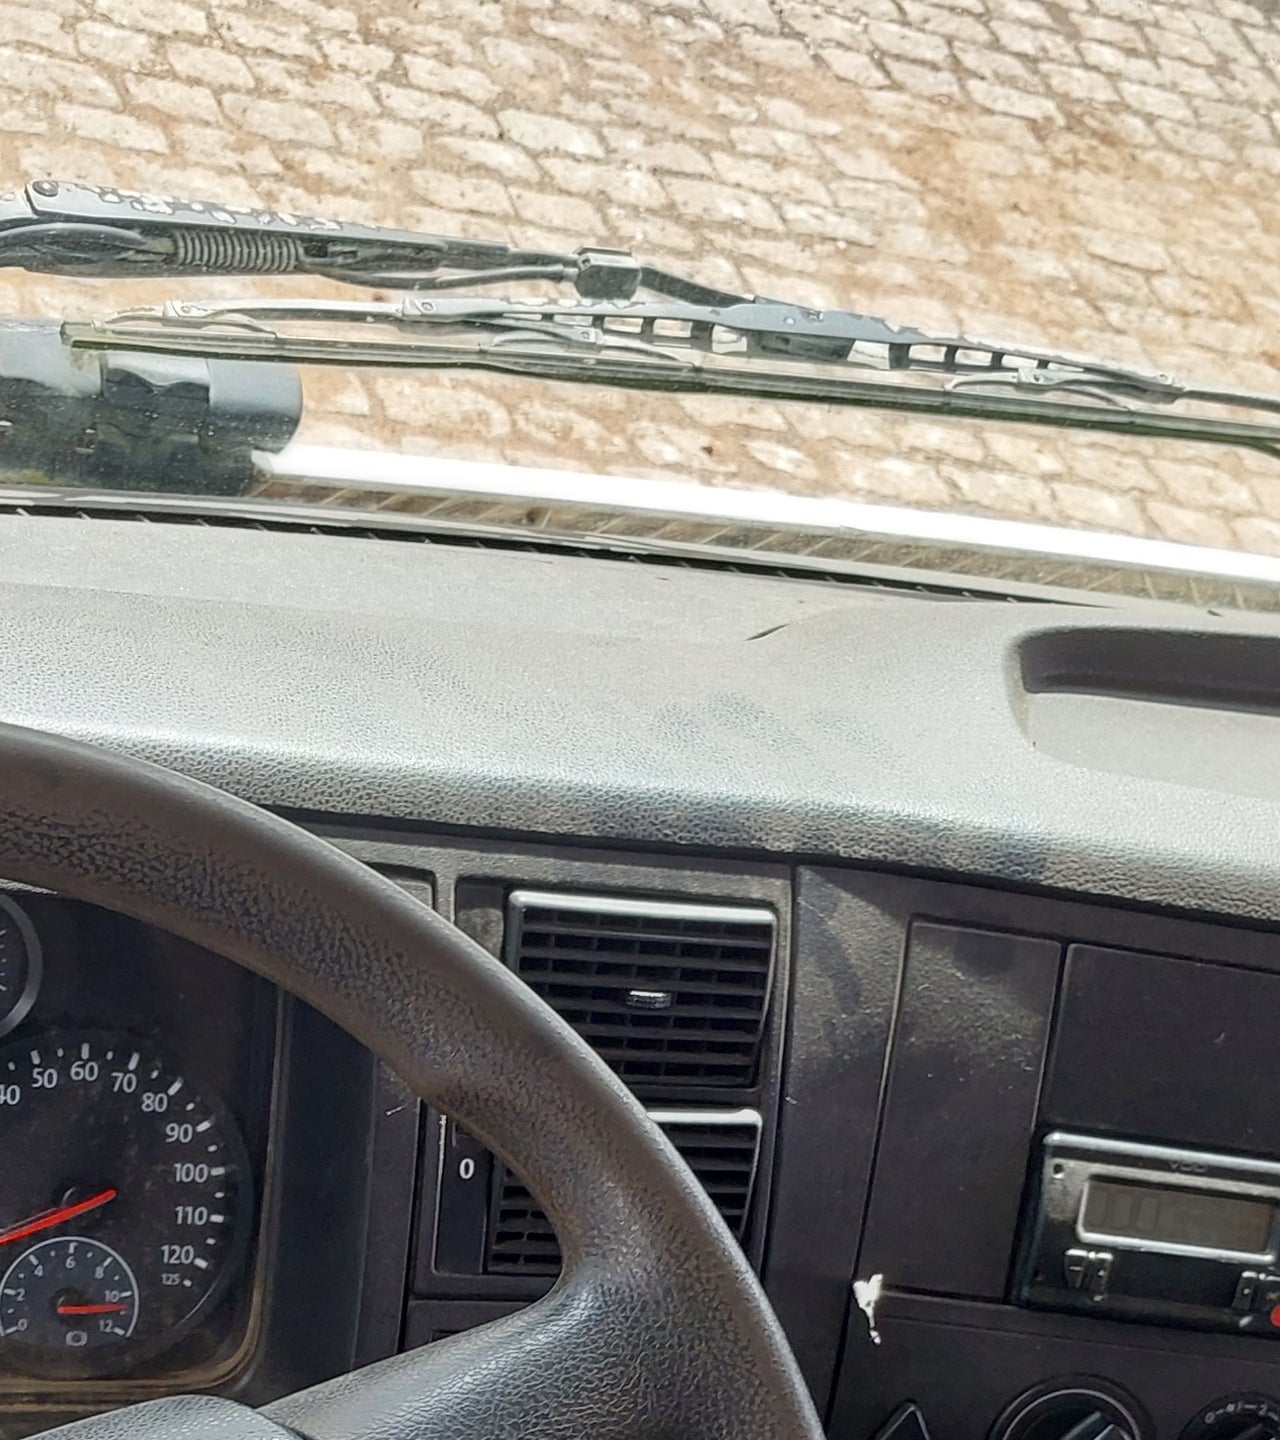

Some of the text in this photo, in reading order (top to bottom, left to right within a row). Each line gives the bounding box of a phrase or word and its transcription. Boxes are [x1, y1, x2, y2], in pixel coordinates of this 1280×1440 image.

[31, 1068, 58, 1088] 50
[70, 1061, 99, 1081] 60
[111, 1073, 137, 1093] 70
[141, 1092, 168, 1112] 80
[165, 1123, 193, 1143] 90
[174, 1163, 209, 1183] 100
[459, 1158, 475, 1180] 0
[175, 1206, 208, 1226] 110
[65, 1256, 76, 1269] 6
[161, 1245, 195, 1265] 120
[34, 1265, 44, 1277] 4
[94, 1266, 105, 1279] 8
[161, 1274, 180, 1286] 125
[16, 1288, 26, 1302] 2
[104, 1290, 121, 1303] 10
[17, 1319, 28, 1332] 0
[100, 1320, 113, 1332] 12
